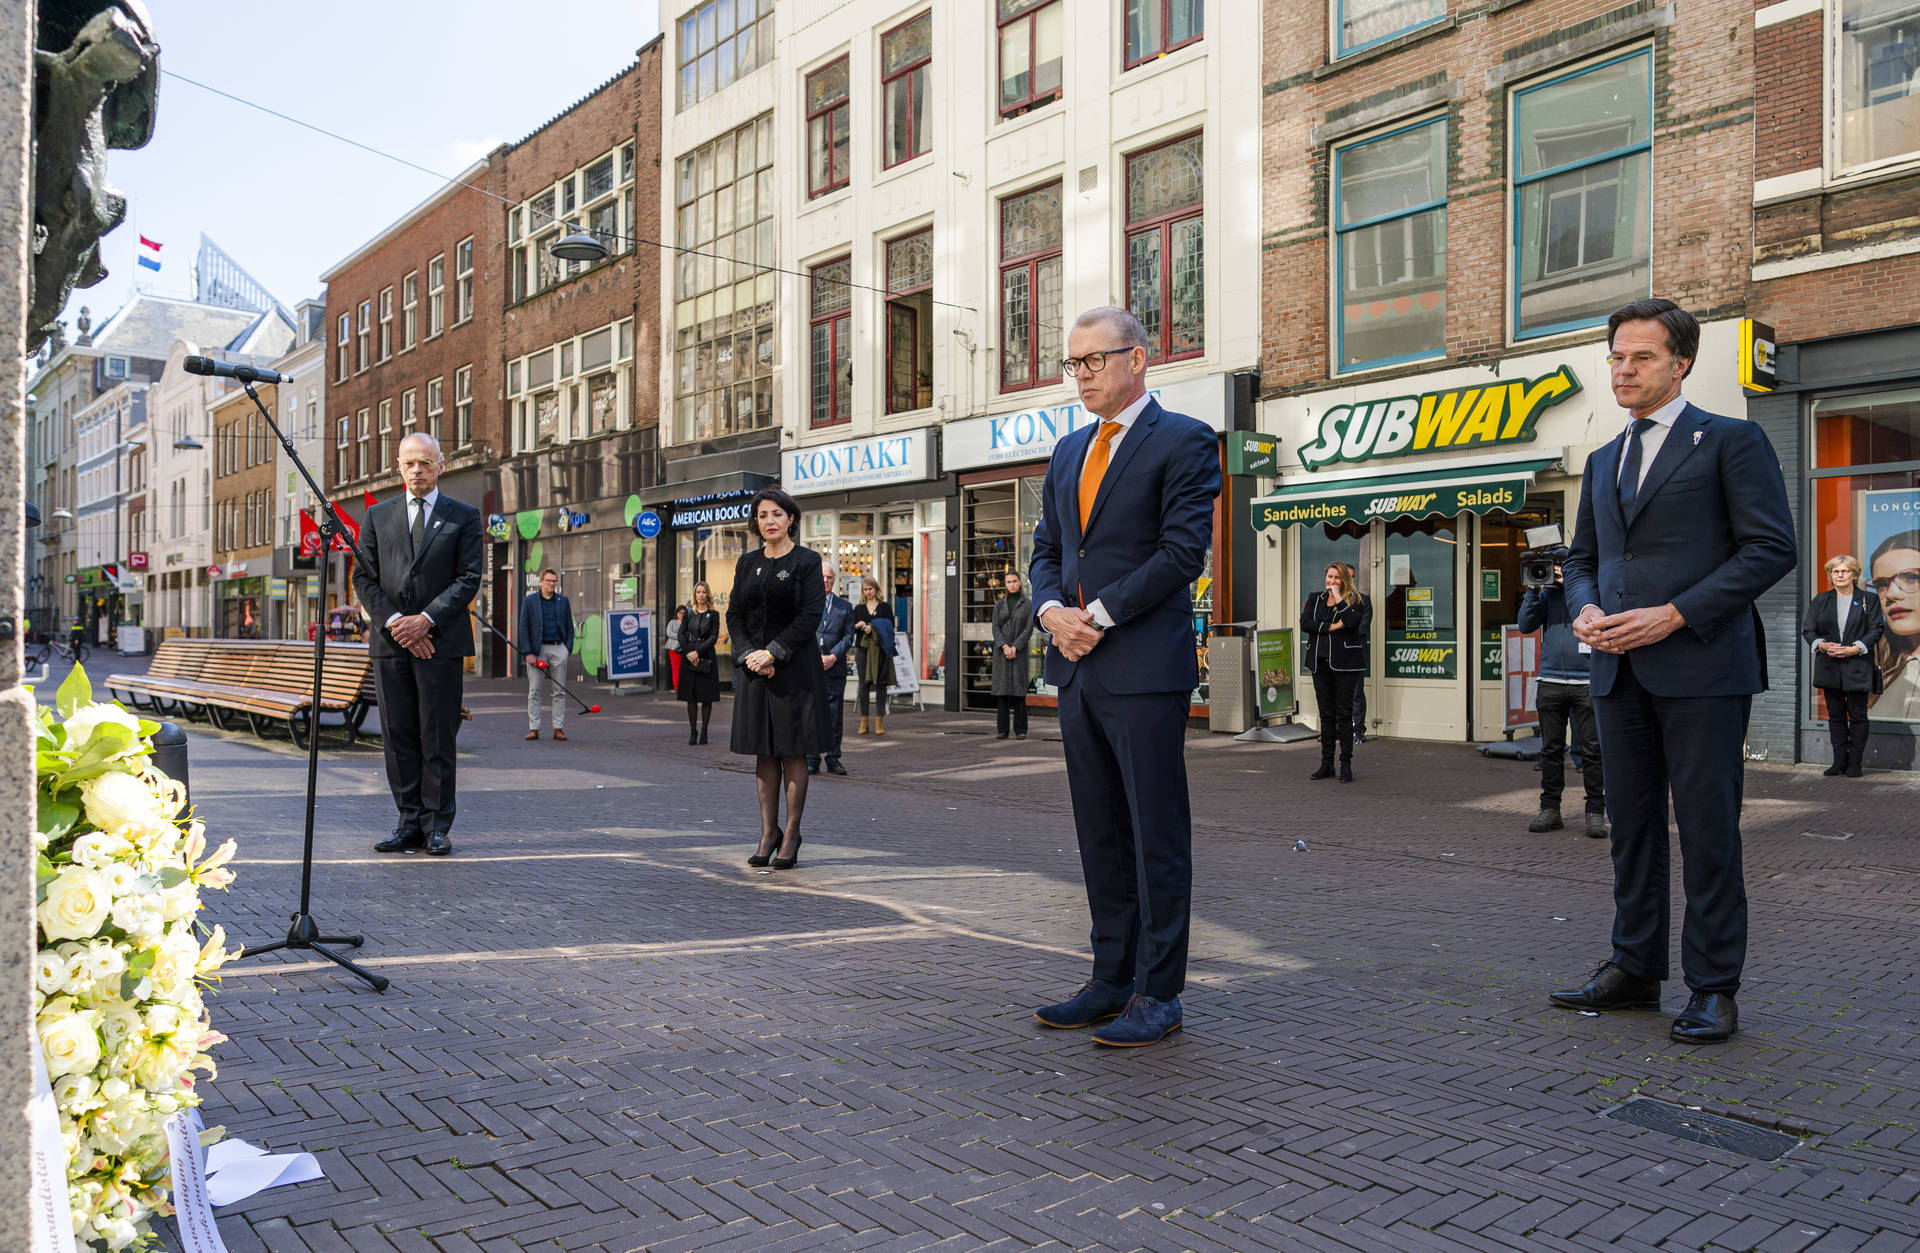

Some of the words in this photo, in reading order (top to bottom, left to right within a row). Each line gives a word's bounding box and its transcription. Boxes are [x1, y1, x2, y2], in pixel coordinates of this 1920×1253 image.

[1302, 371, 1572, 463] SUBWAY
[1243, 440, 1275, 455] SUBWAY
[793, 436, 913, 481] KONTAKT
[1263, 503, 1347, 522] Sandwiches
[1364, 492, 1438, 515] SUBWAY
[1457, 488, 1513, 507] Salads
[569, 512, 587, 528] kpn
[641, 517, 656, 527] ABC
[672, 509, 713, 527] AMERICAN
[715, 505, 740, 521] BOOK
[946, 551, 956, 560] 21
[1405, 632, 1438, 640] SALADS
[1390, 648, 1453, 662] SUBWAY
[1399, 665, 1415, 674] eat
[1417, 664, 1445, 674] fresh
